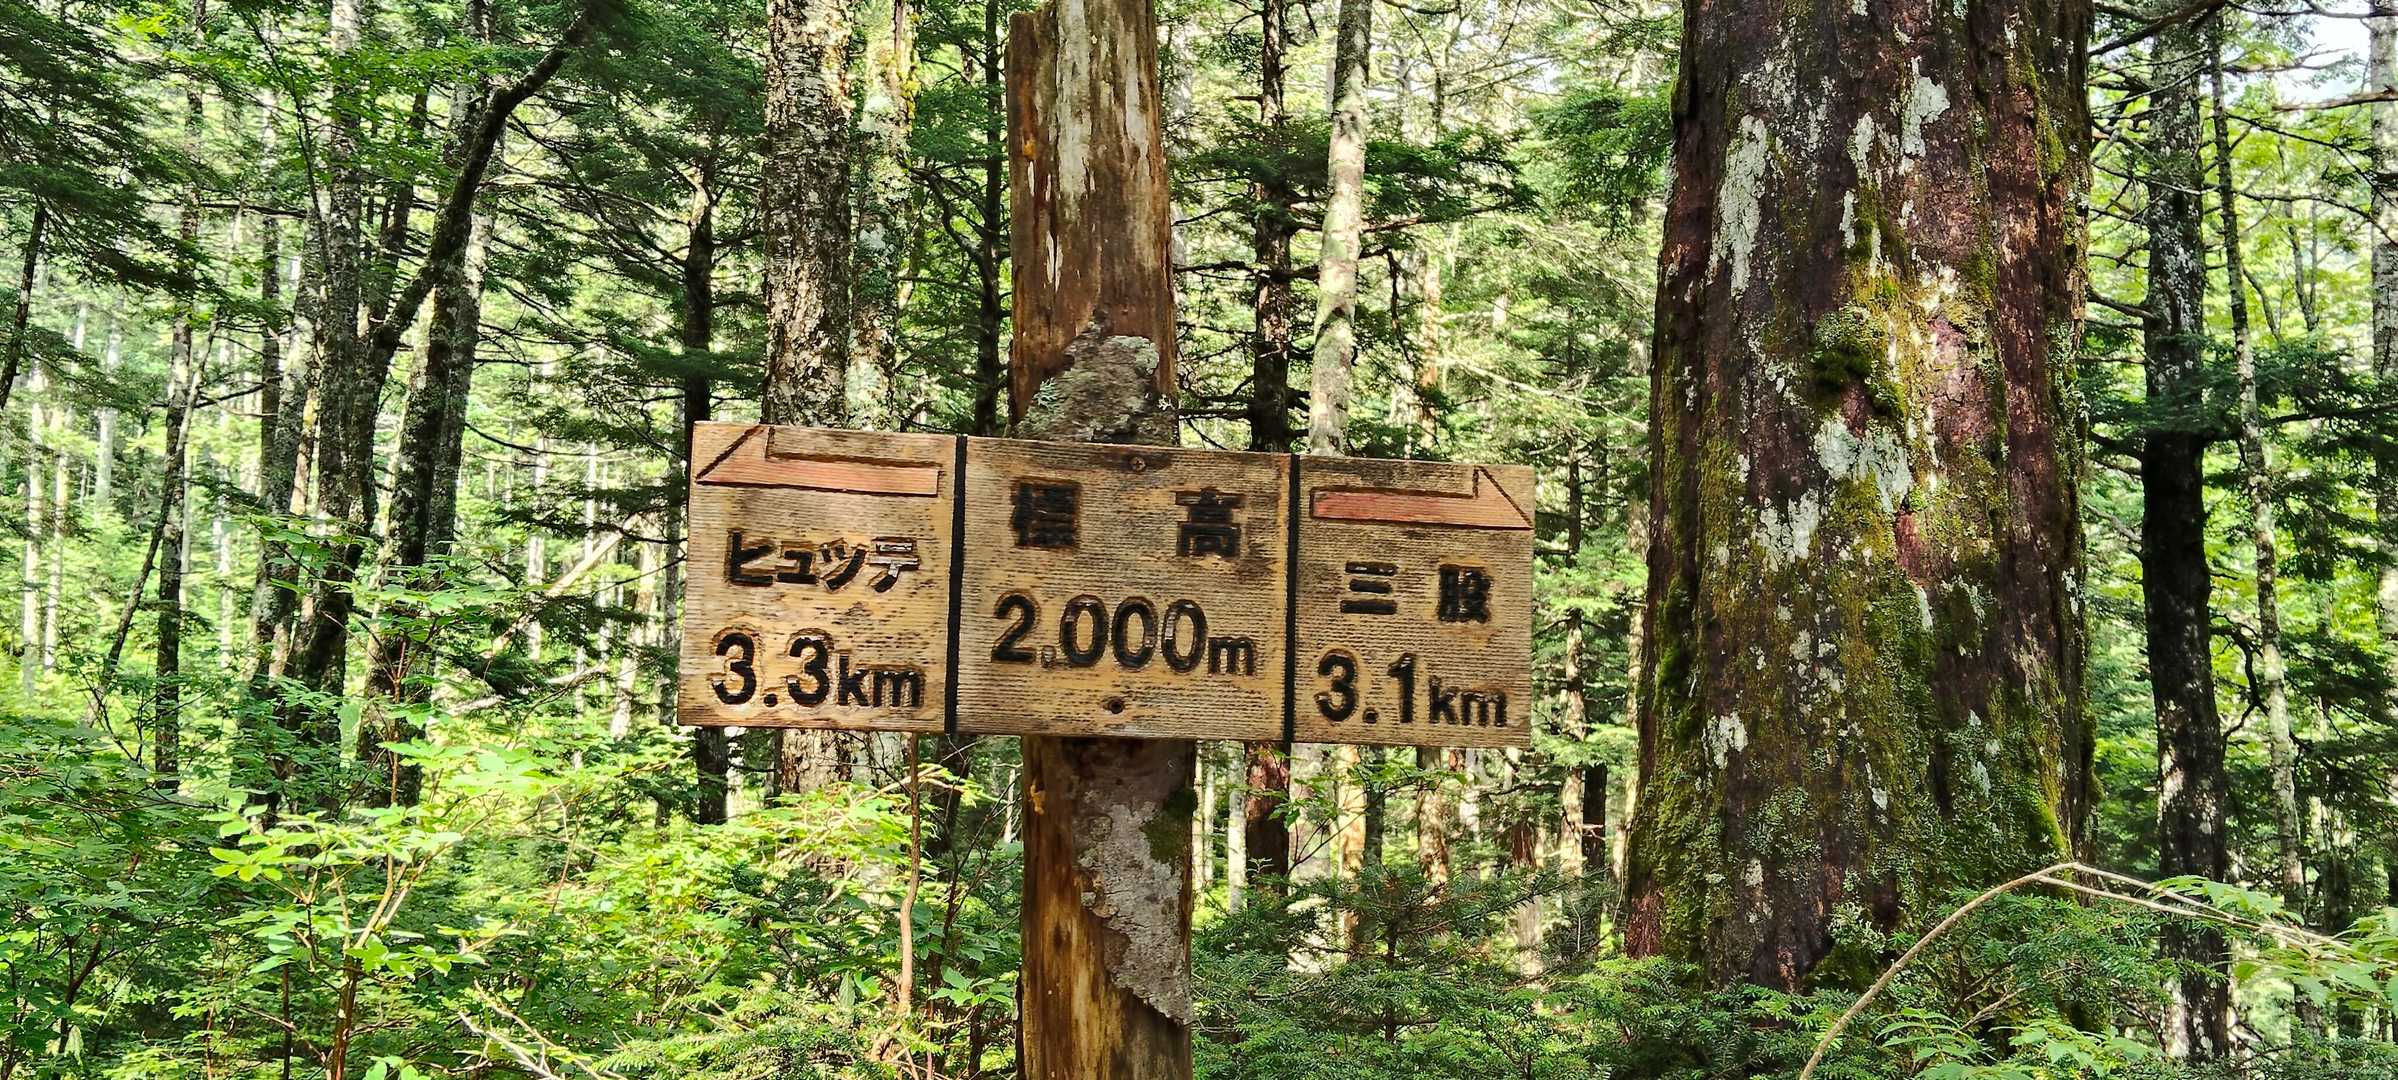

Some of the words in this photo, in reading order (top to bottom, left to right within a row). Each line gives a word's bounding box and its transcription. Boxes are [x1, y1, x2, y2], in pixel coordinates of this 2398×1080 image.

[1010, 477, 1245, 558] 標高
[1340, 558, 1494, 623] 三股
[709, 626, 926, 708] 3.3km
[1314, 649, 1508, 728] 3.1km
